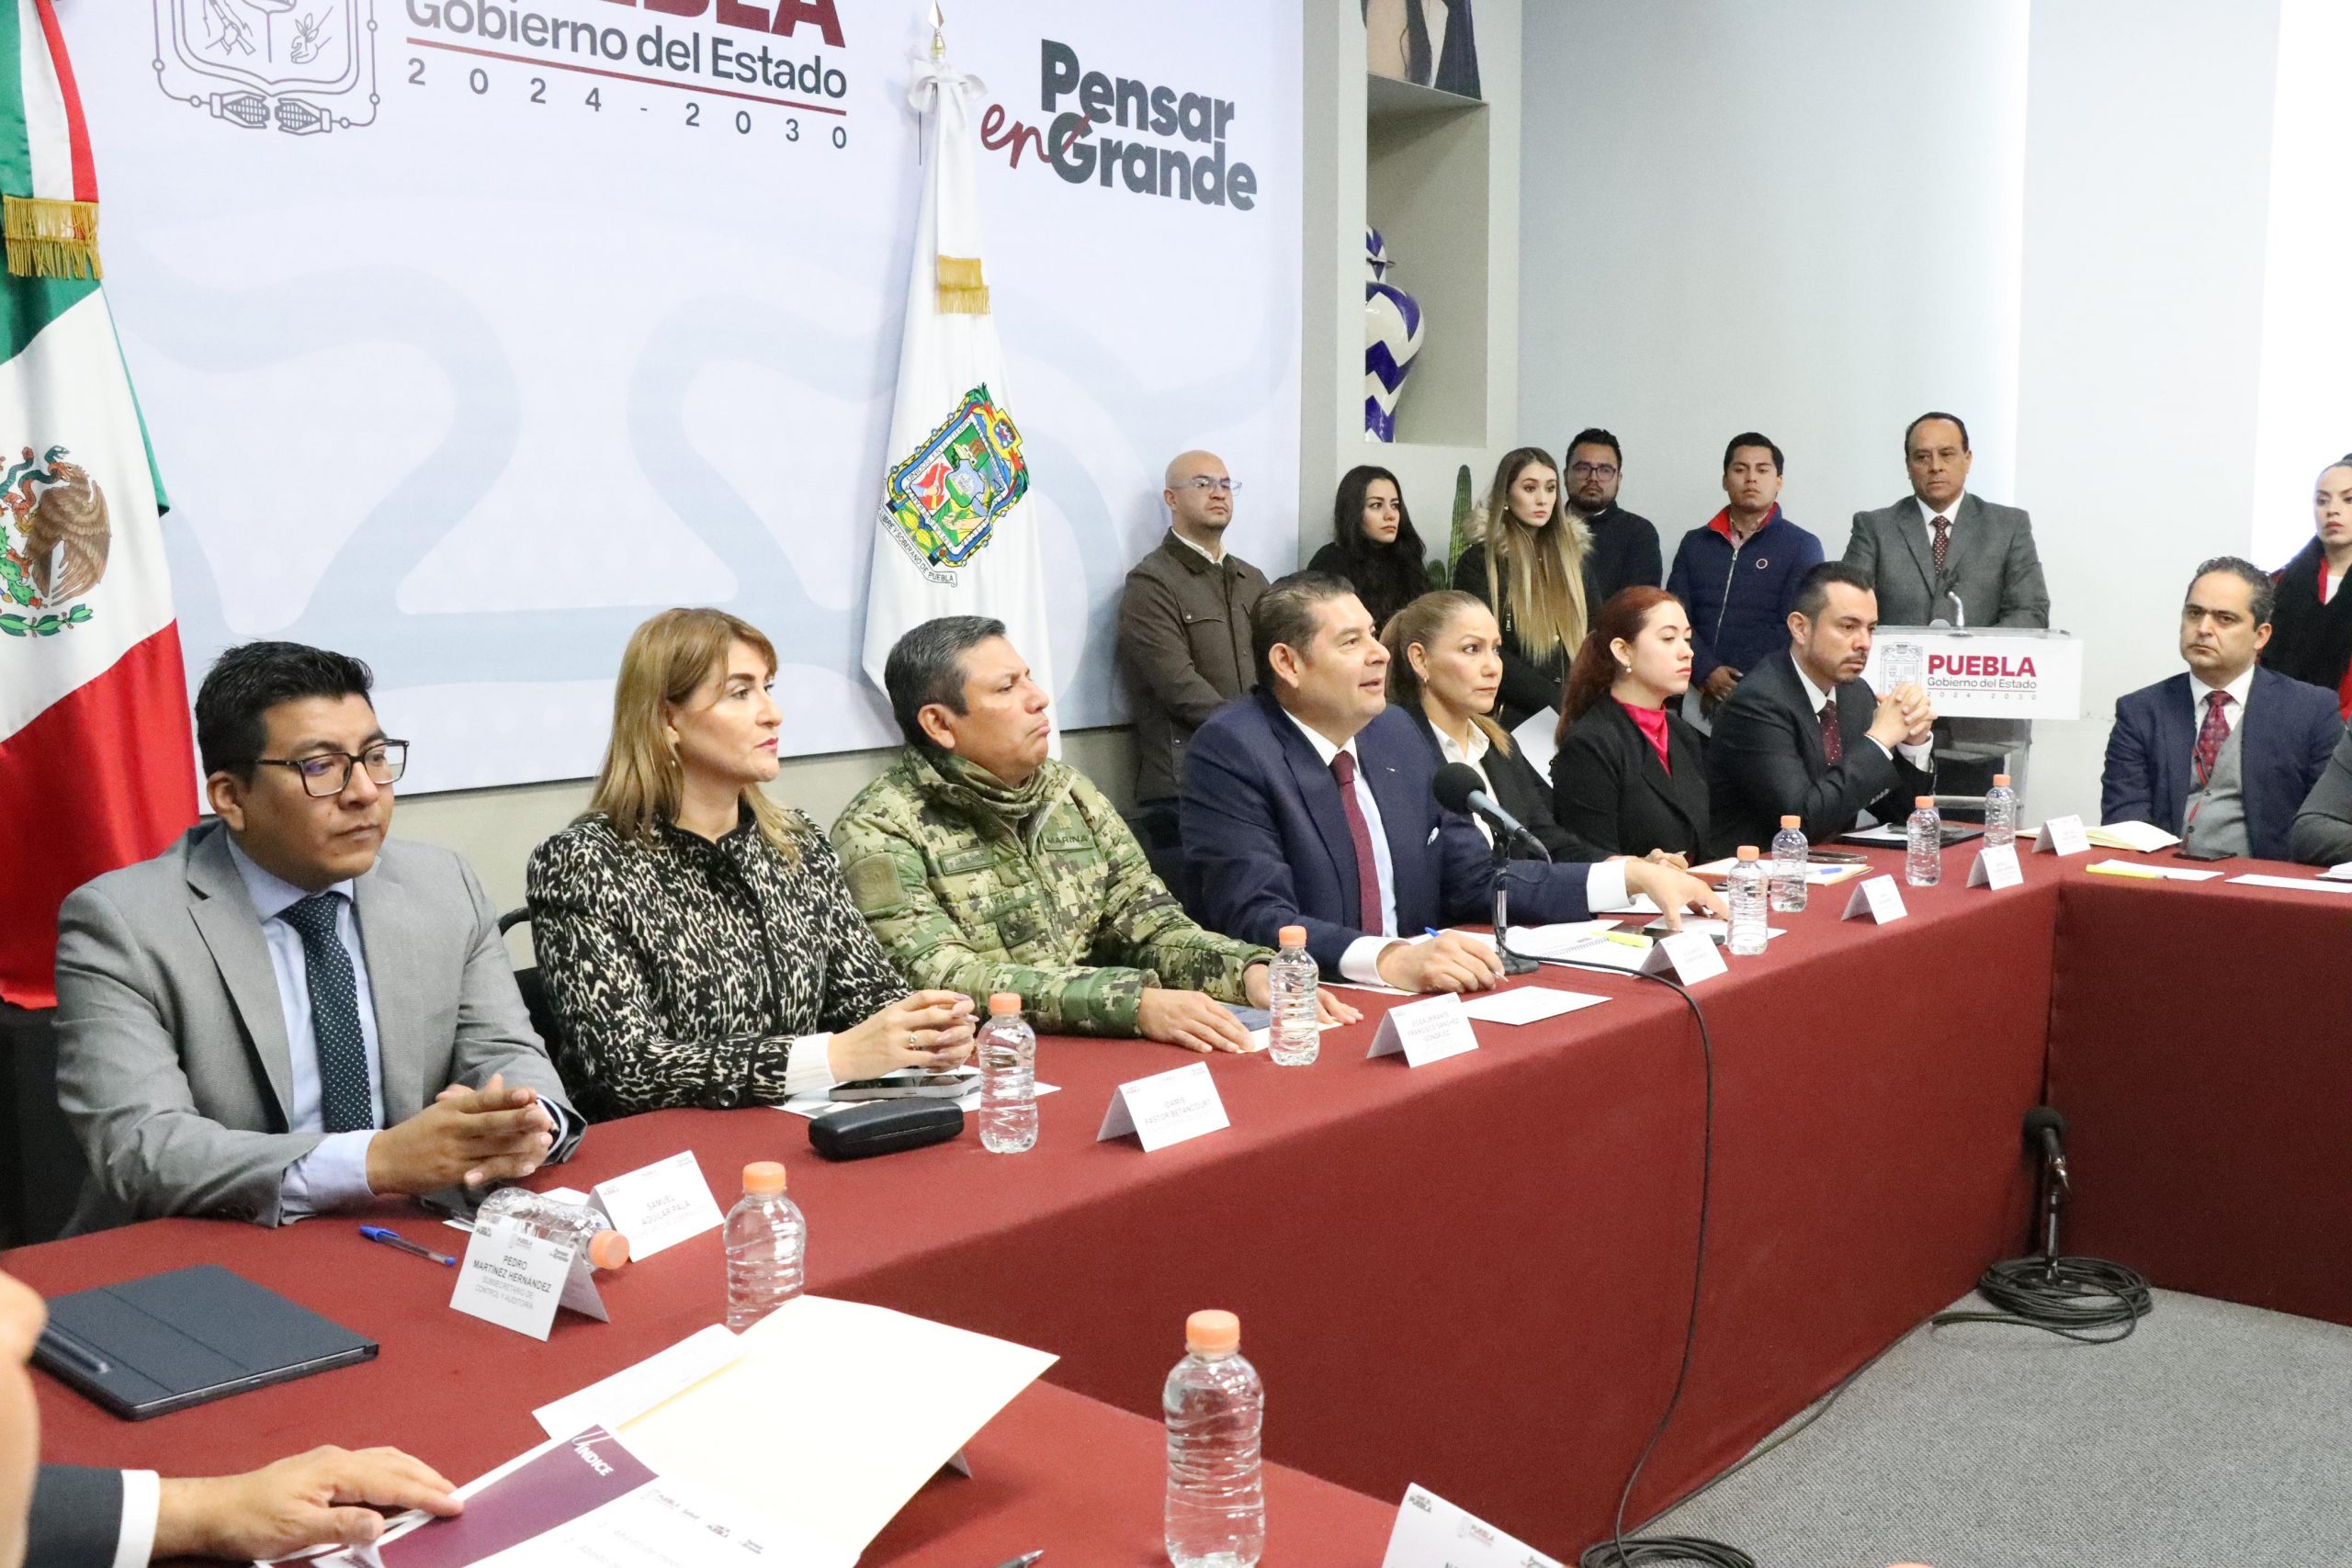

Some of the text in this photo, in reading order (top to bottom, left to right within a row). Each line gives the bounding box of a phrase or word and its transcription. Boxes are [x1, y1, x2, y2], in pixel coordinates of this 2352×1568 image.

[405, 0, 628, 61] Gobierno
[636, 25, 701, 73] del
[711, 37, 847, 99] Estado
[1041, 39, 1235, 144] Pensar
[980, 104, 1258, 211] en Grande
[905, 458, 931, 481] UNIDOS
[879, 510, 895, 530] LIBRE
[895, 531, 923, 566] SOBERANO
[920, 563, 930, 574] DE
[928, 571, 955, 582] PUEBLA
[1927, 654, 2037, 677] PUEBLA
[1927, 676, 2037, 689] Gobierno del Estado
[1046, 834, 1089, 844] MARINA
[646, 1194, 676, 1211] SAMUEL
[503, 1255, 528, 1270] PEDRO
